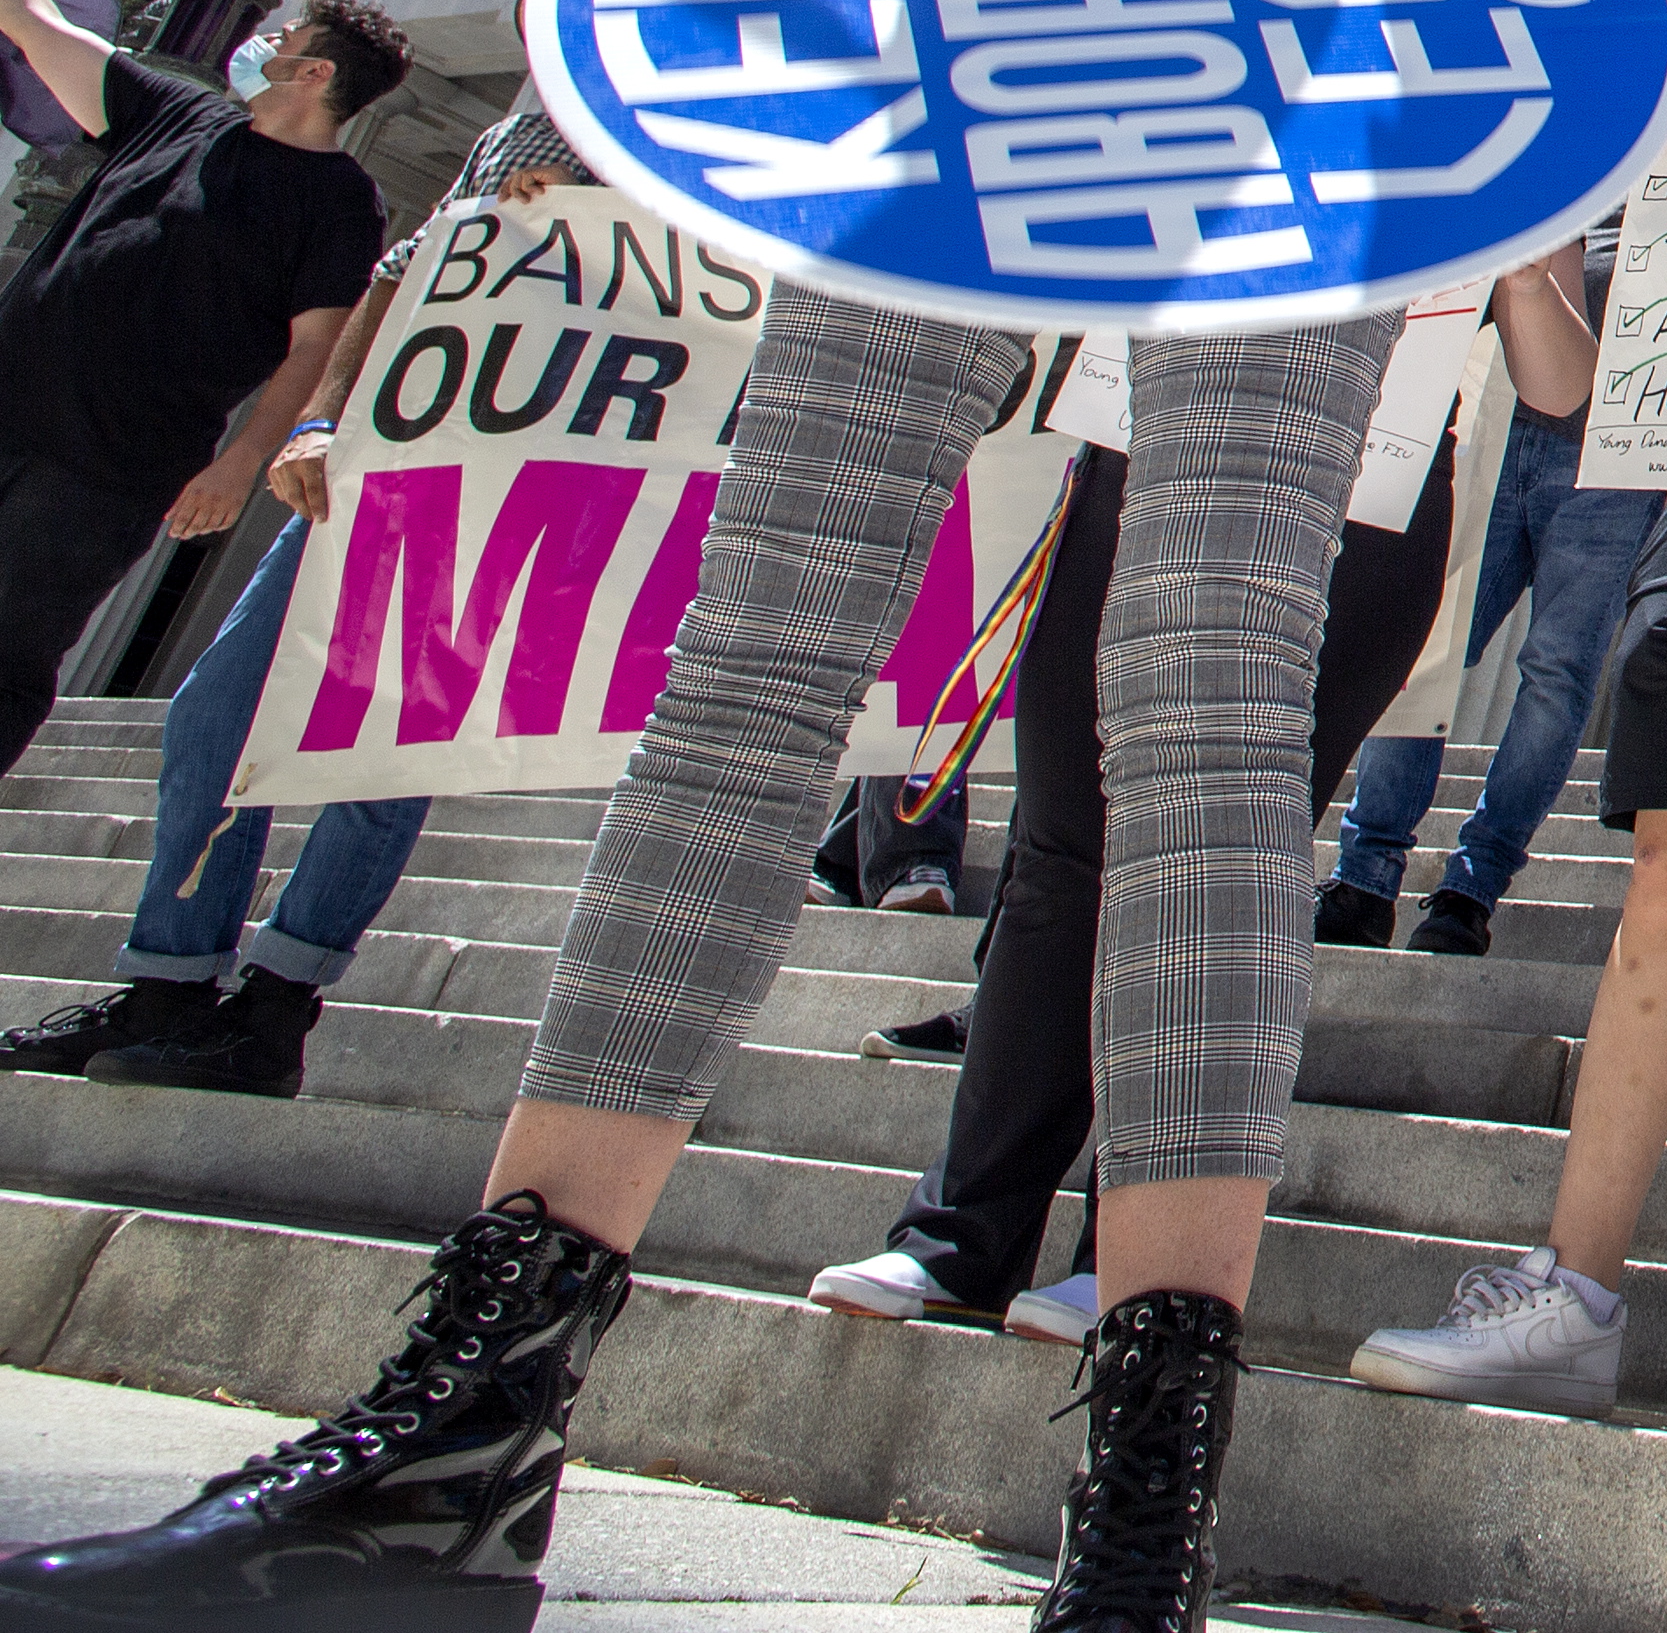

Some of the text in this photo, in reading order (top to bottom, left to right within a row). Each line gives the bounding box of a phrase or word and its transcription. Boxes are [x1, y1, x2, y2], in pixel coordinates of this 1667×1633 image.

[424, 213, 762, 322] BANS
[372, 323, 690, 442] OUR
[1080, 356, 1119, 389] Young
[1382, 441, 1415, 459] FIU
[1599, 433, 1632, 456] Young
